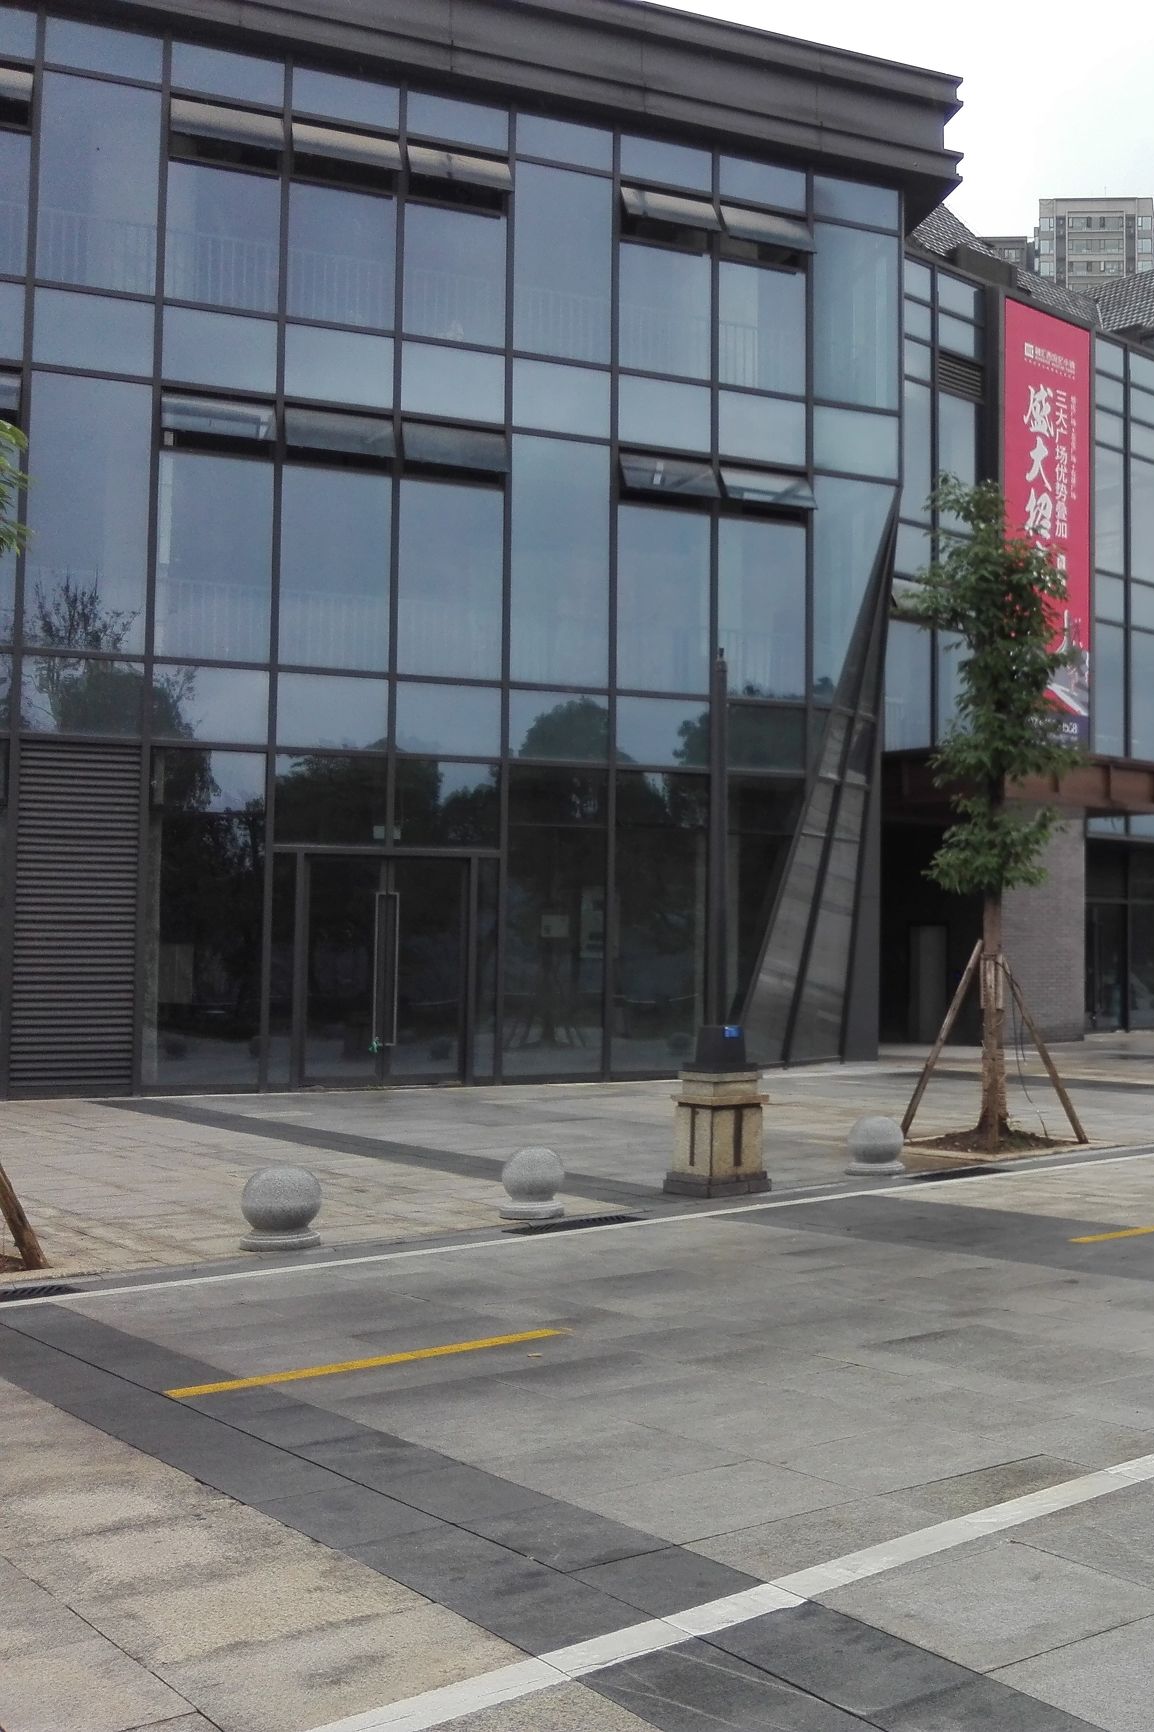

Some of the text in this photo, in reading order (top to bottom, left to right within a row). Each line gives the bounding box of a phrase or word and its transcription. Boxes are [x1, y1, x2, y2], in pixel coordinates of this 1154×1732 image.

[1023, 383, 1054, 595] 盛大招
[1055, 390, 1068, 538] 三大广场优势叠加
